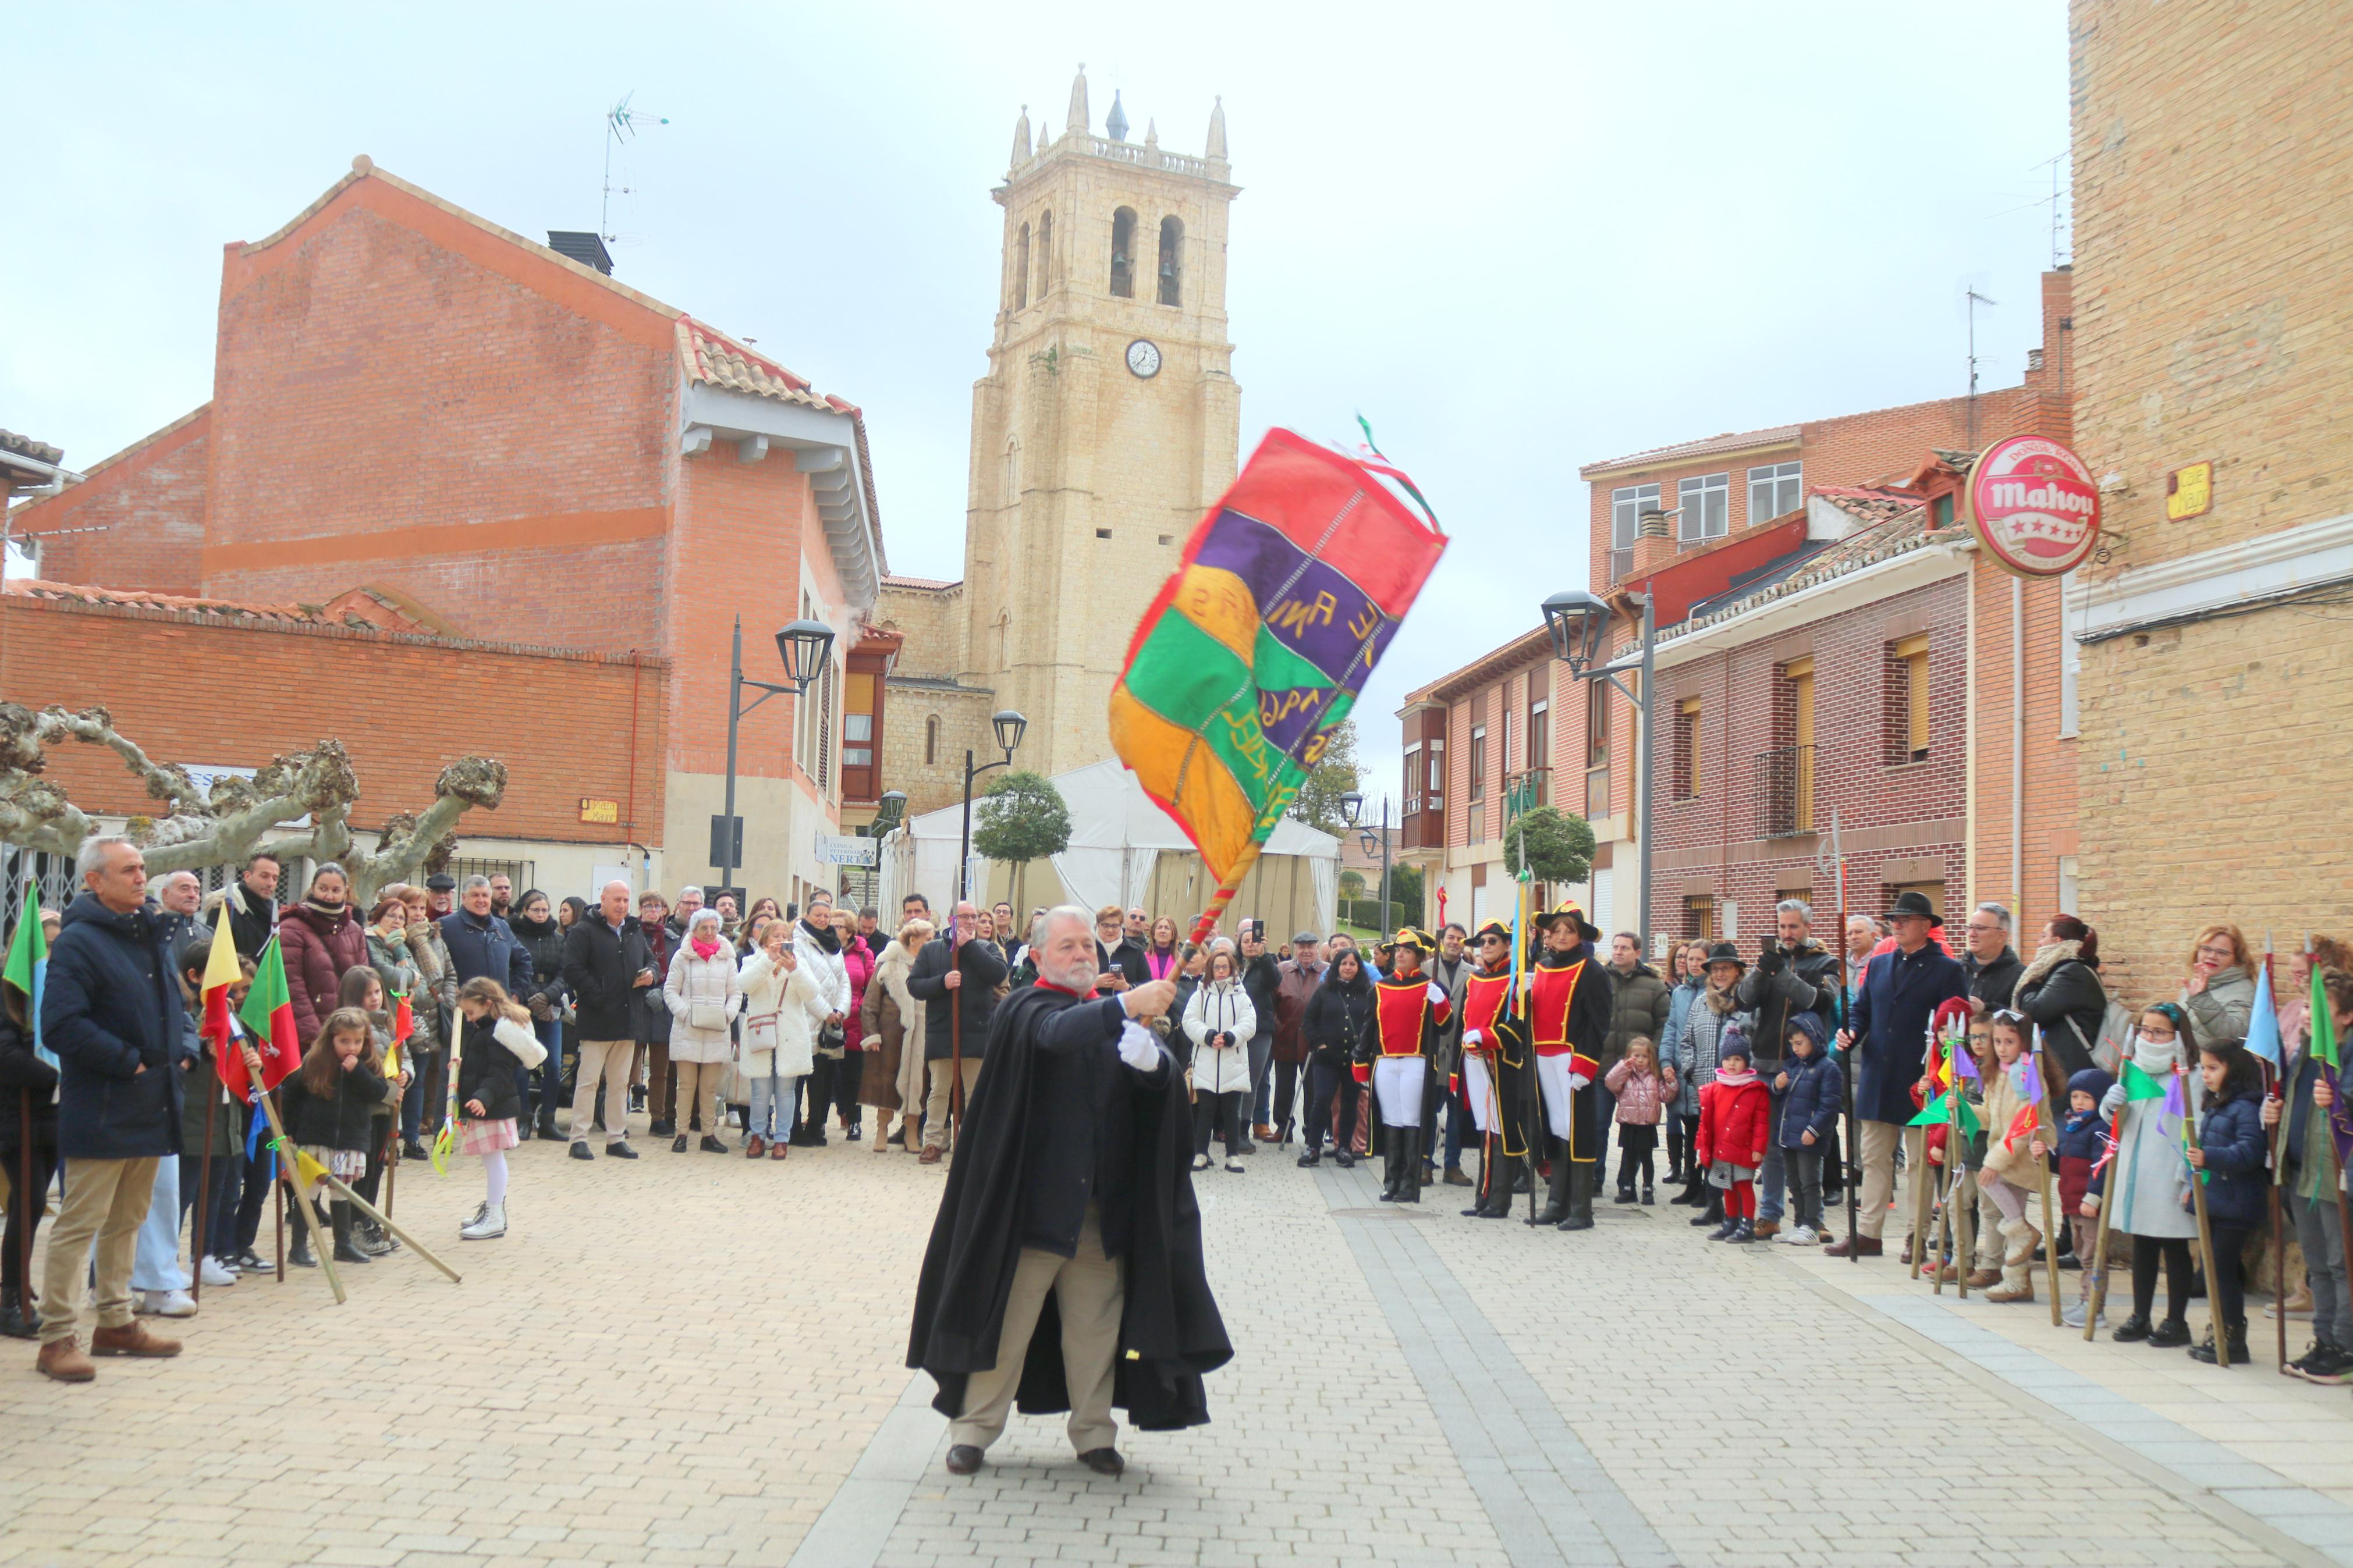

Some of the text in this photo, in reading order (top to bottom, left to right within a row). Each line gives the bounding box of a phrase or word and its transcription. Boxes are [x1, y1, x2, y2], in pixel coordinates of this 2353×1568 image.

[2180, 467, 2203, 488] Calle
[1990, 482, 2095, 516] Mahou
[2177, 489, 2208, 513] Mayor
[592, 800, 615, 810] Plaza
